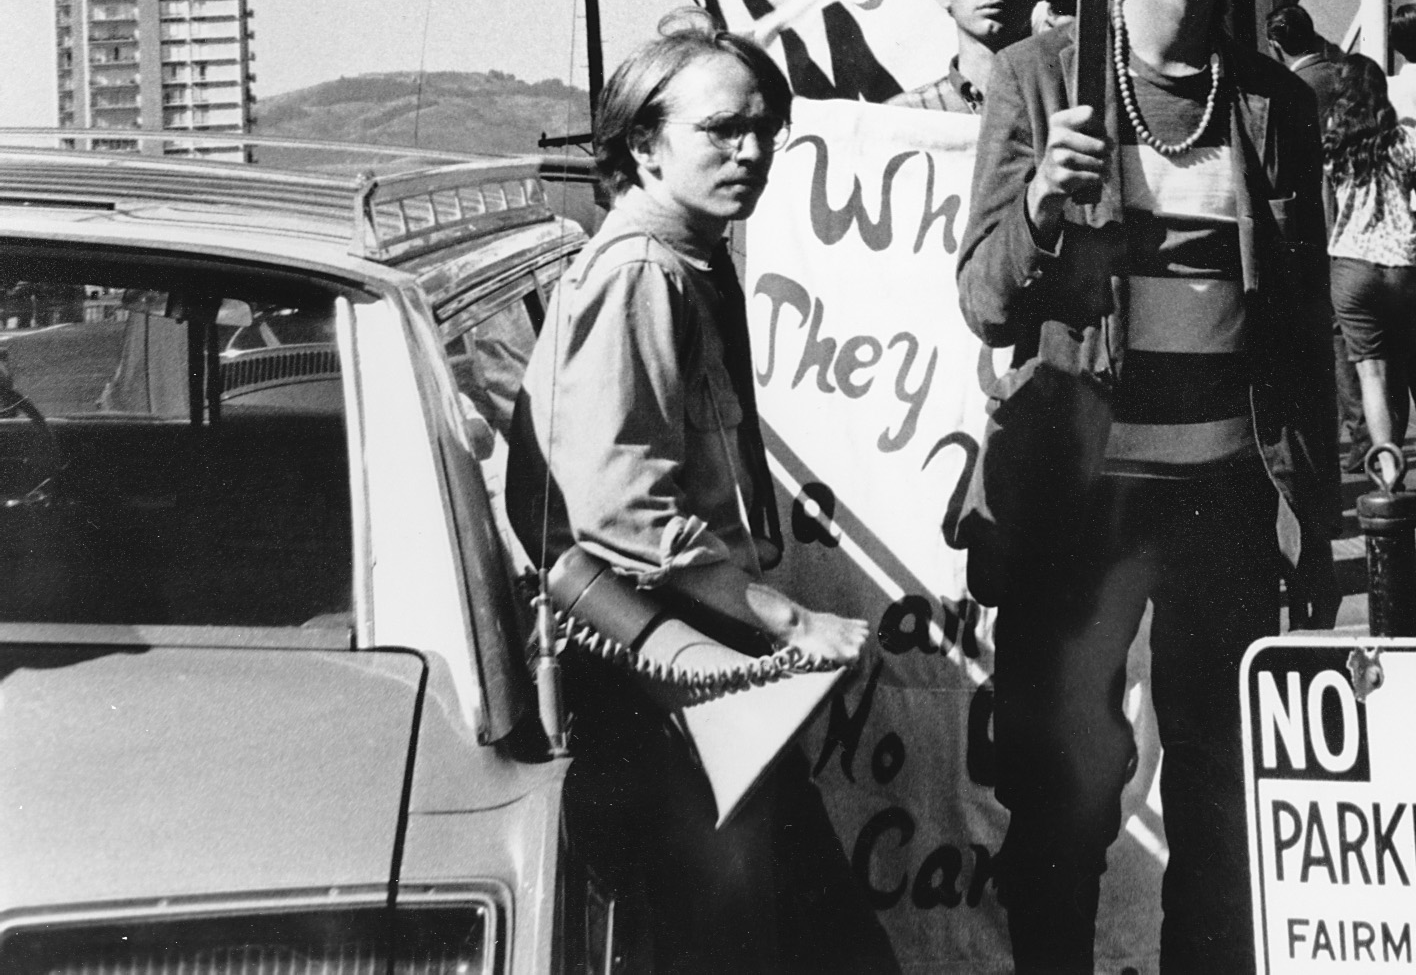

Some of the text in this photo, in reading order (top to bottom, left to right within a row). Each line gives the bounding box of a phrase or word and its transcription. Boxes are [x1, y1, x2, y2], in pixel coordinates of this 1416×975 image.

[785, 134, 962, 255] Wh
[753, 272, 939, 454] They
[1257, 670, 1361, 773] NO
